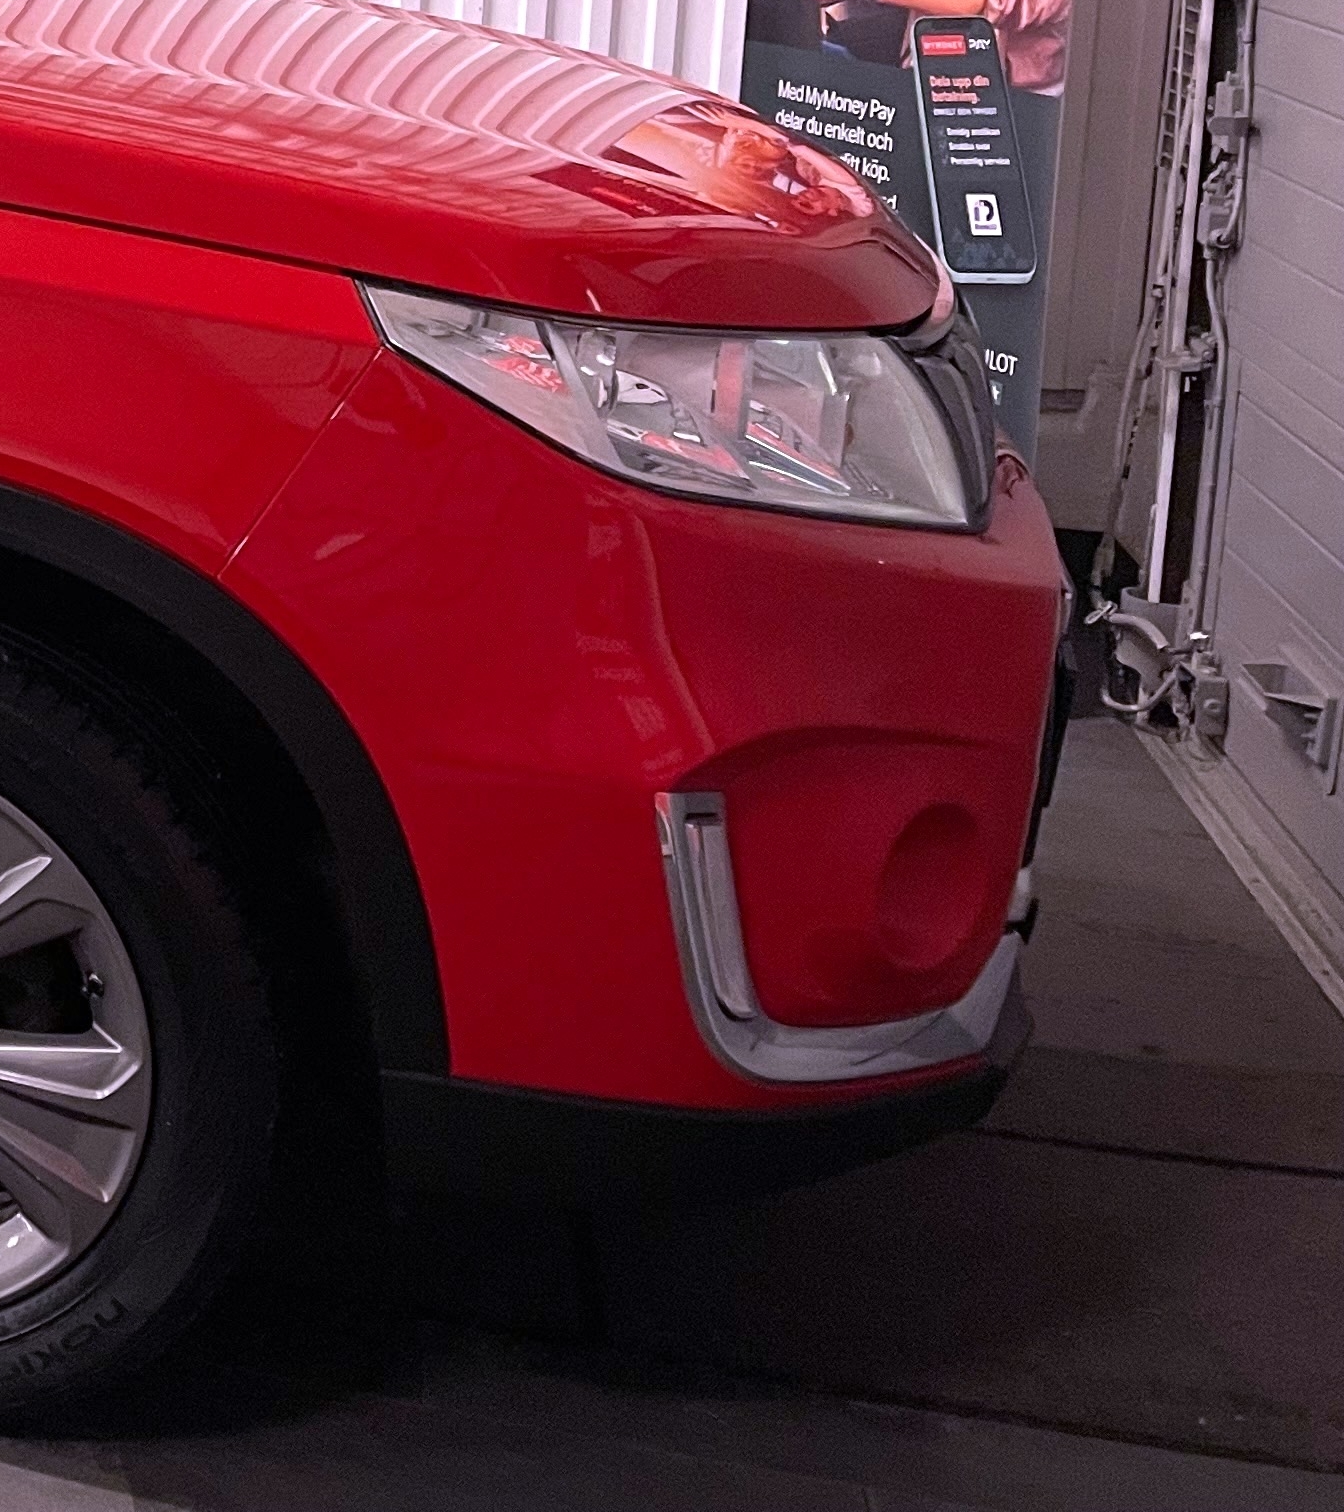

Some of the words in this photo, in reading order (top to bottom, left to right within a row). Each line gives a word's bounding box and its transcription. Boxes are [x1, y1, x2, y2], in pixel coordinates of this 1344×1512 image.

[777, 79, 805, 103] Med
[805, 85, 868, 120] MyMoney
[869, 98, 896, 126] Pay
[775, 108, 806, 130] delar
[806, 115, 823, 136] du
[824, 122, 865, 146] enkelt
[867, 131, 893, 152] och
[861, 156, 891, 185] köp.
